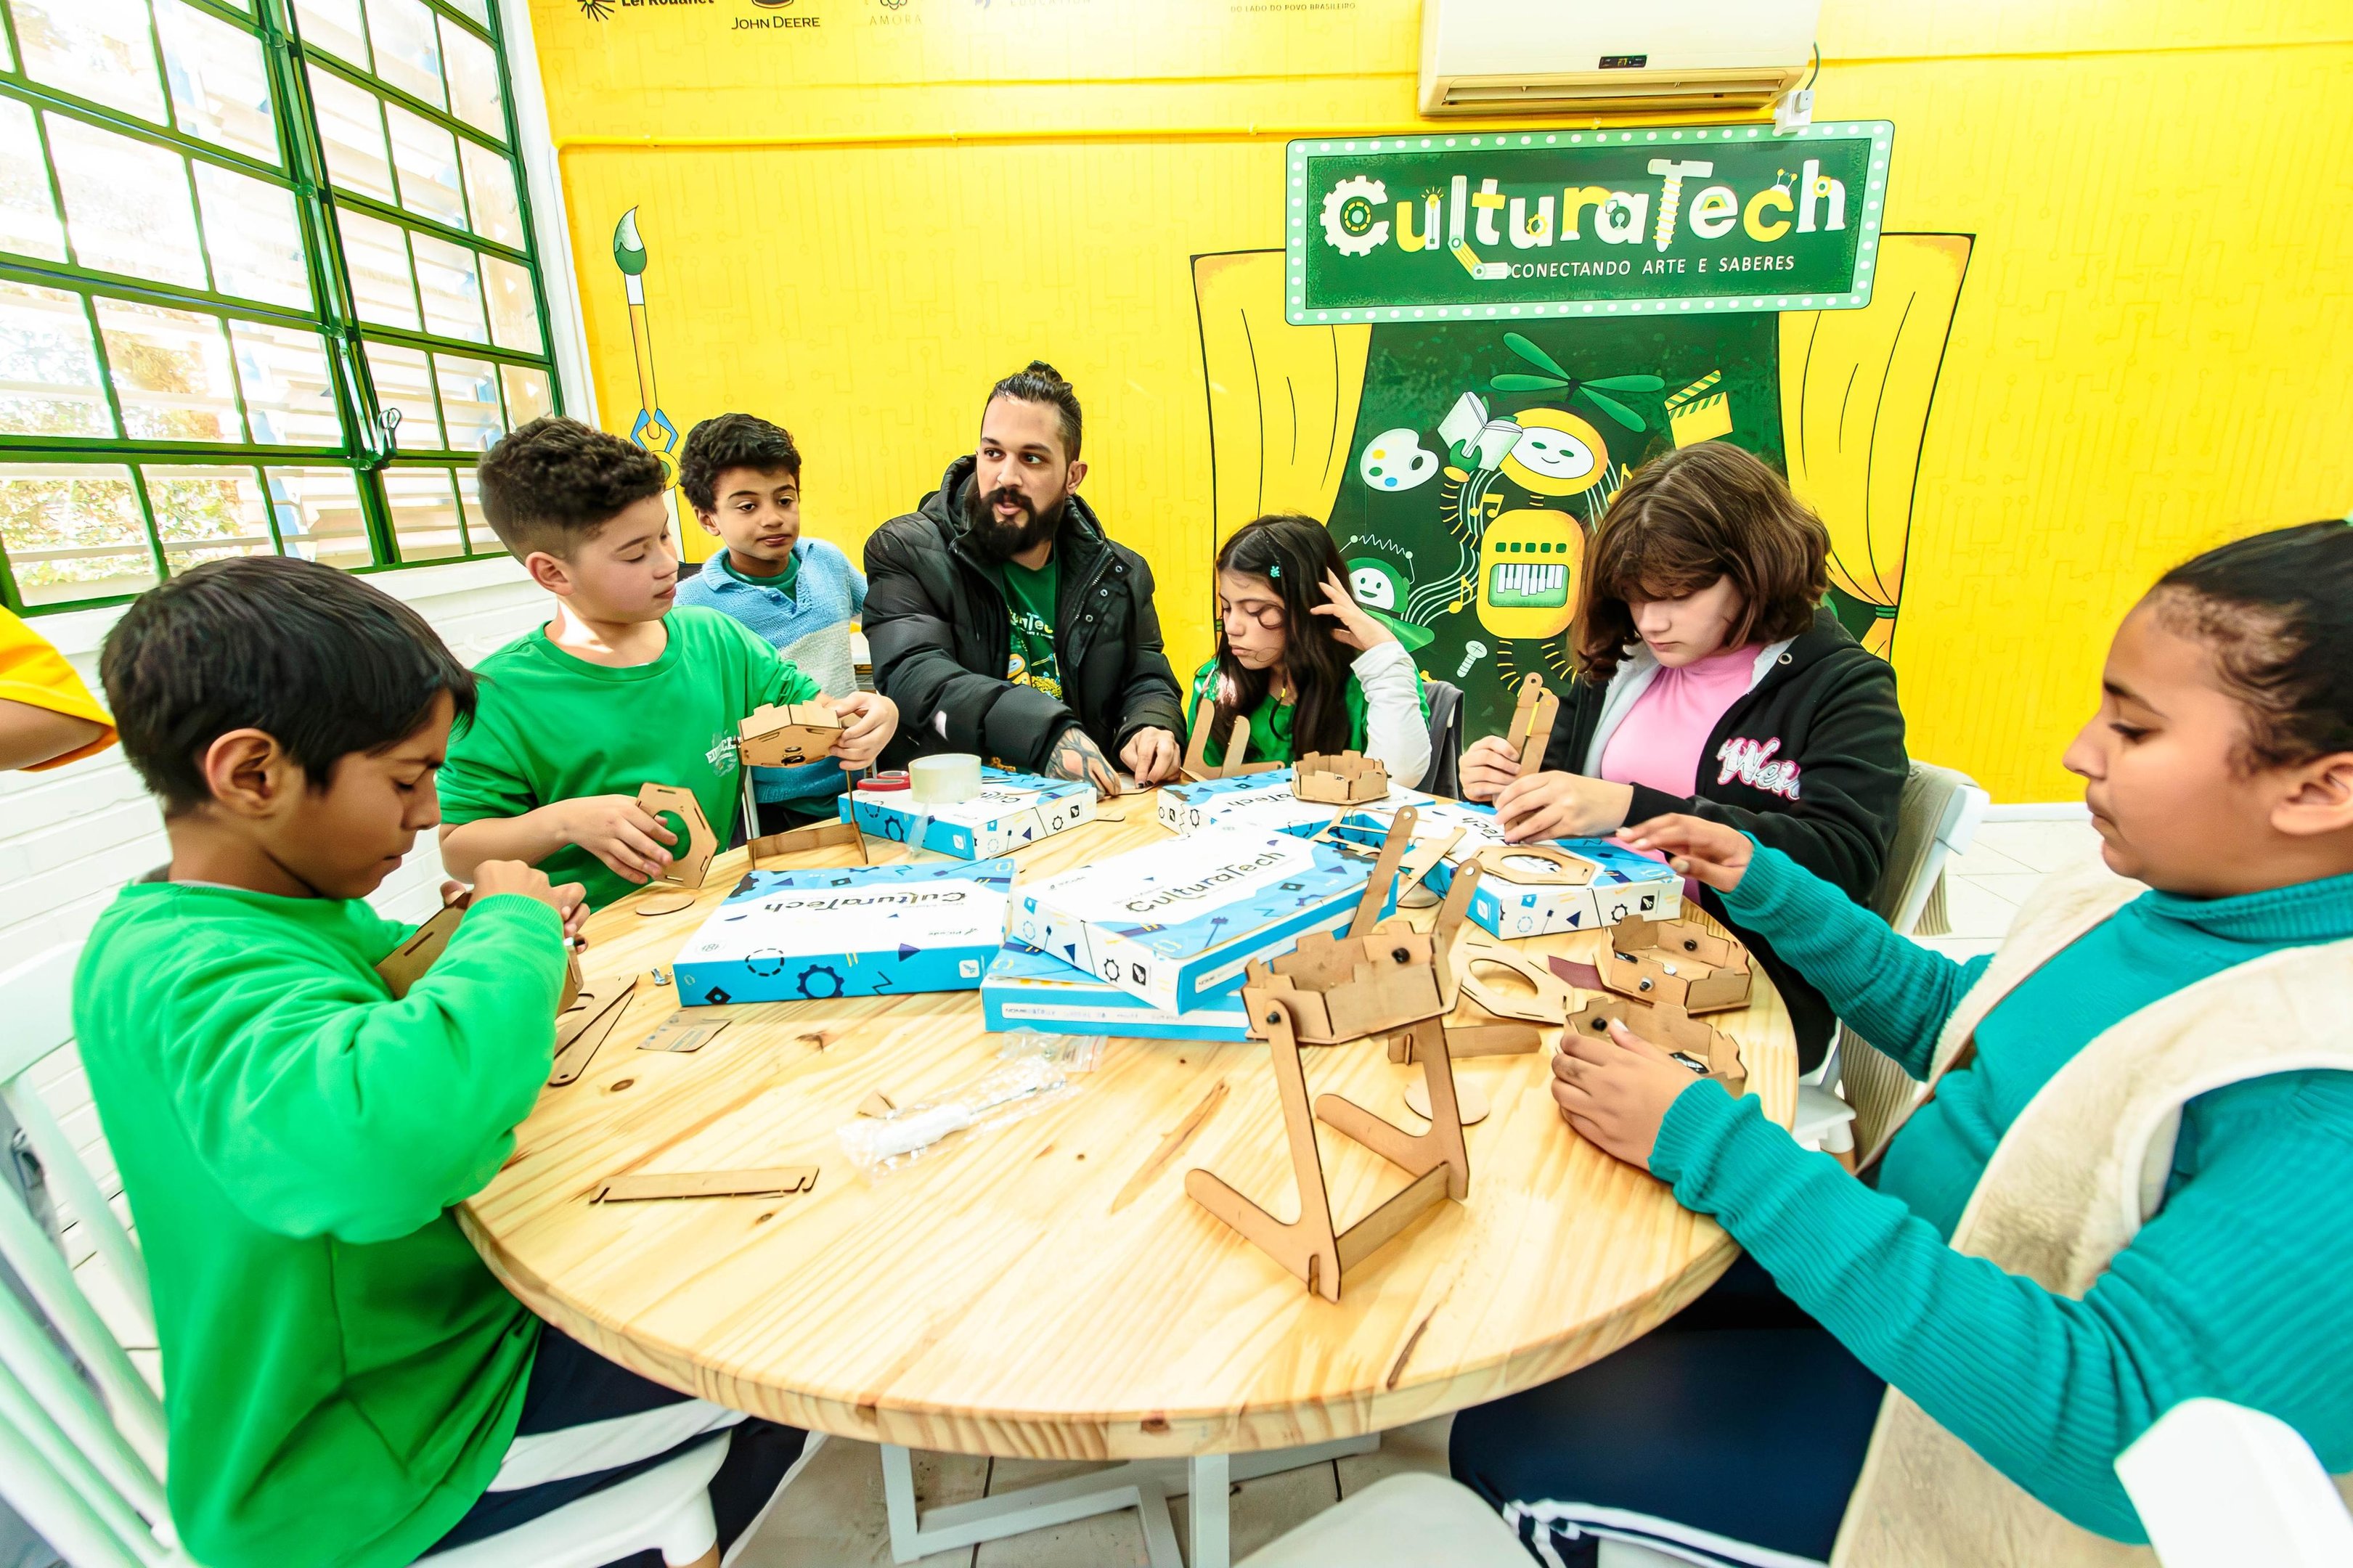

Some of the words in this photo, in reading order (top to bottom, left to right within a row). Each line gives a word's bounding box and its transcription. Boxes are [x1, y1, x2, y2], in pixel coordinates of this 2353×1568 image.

[731, 16, 770, 30] JOHN
[772, 16, 820, 28] DEERE
[869, 14, 922, 26] AMORA
[1319, 158, 1846, 279] CulturaTech
[1511, 260, 1631, 279] CONECTANDO
[1642, 258, 1687, 274] ARTE
[1697, 258, 1708, 274] E
[1718, 256, 1795, 272] SABERES
[1126, 852, 1286, 912] CulturaTech
[764, 892, 967, 912] CulturaTech
